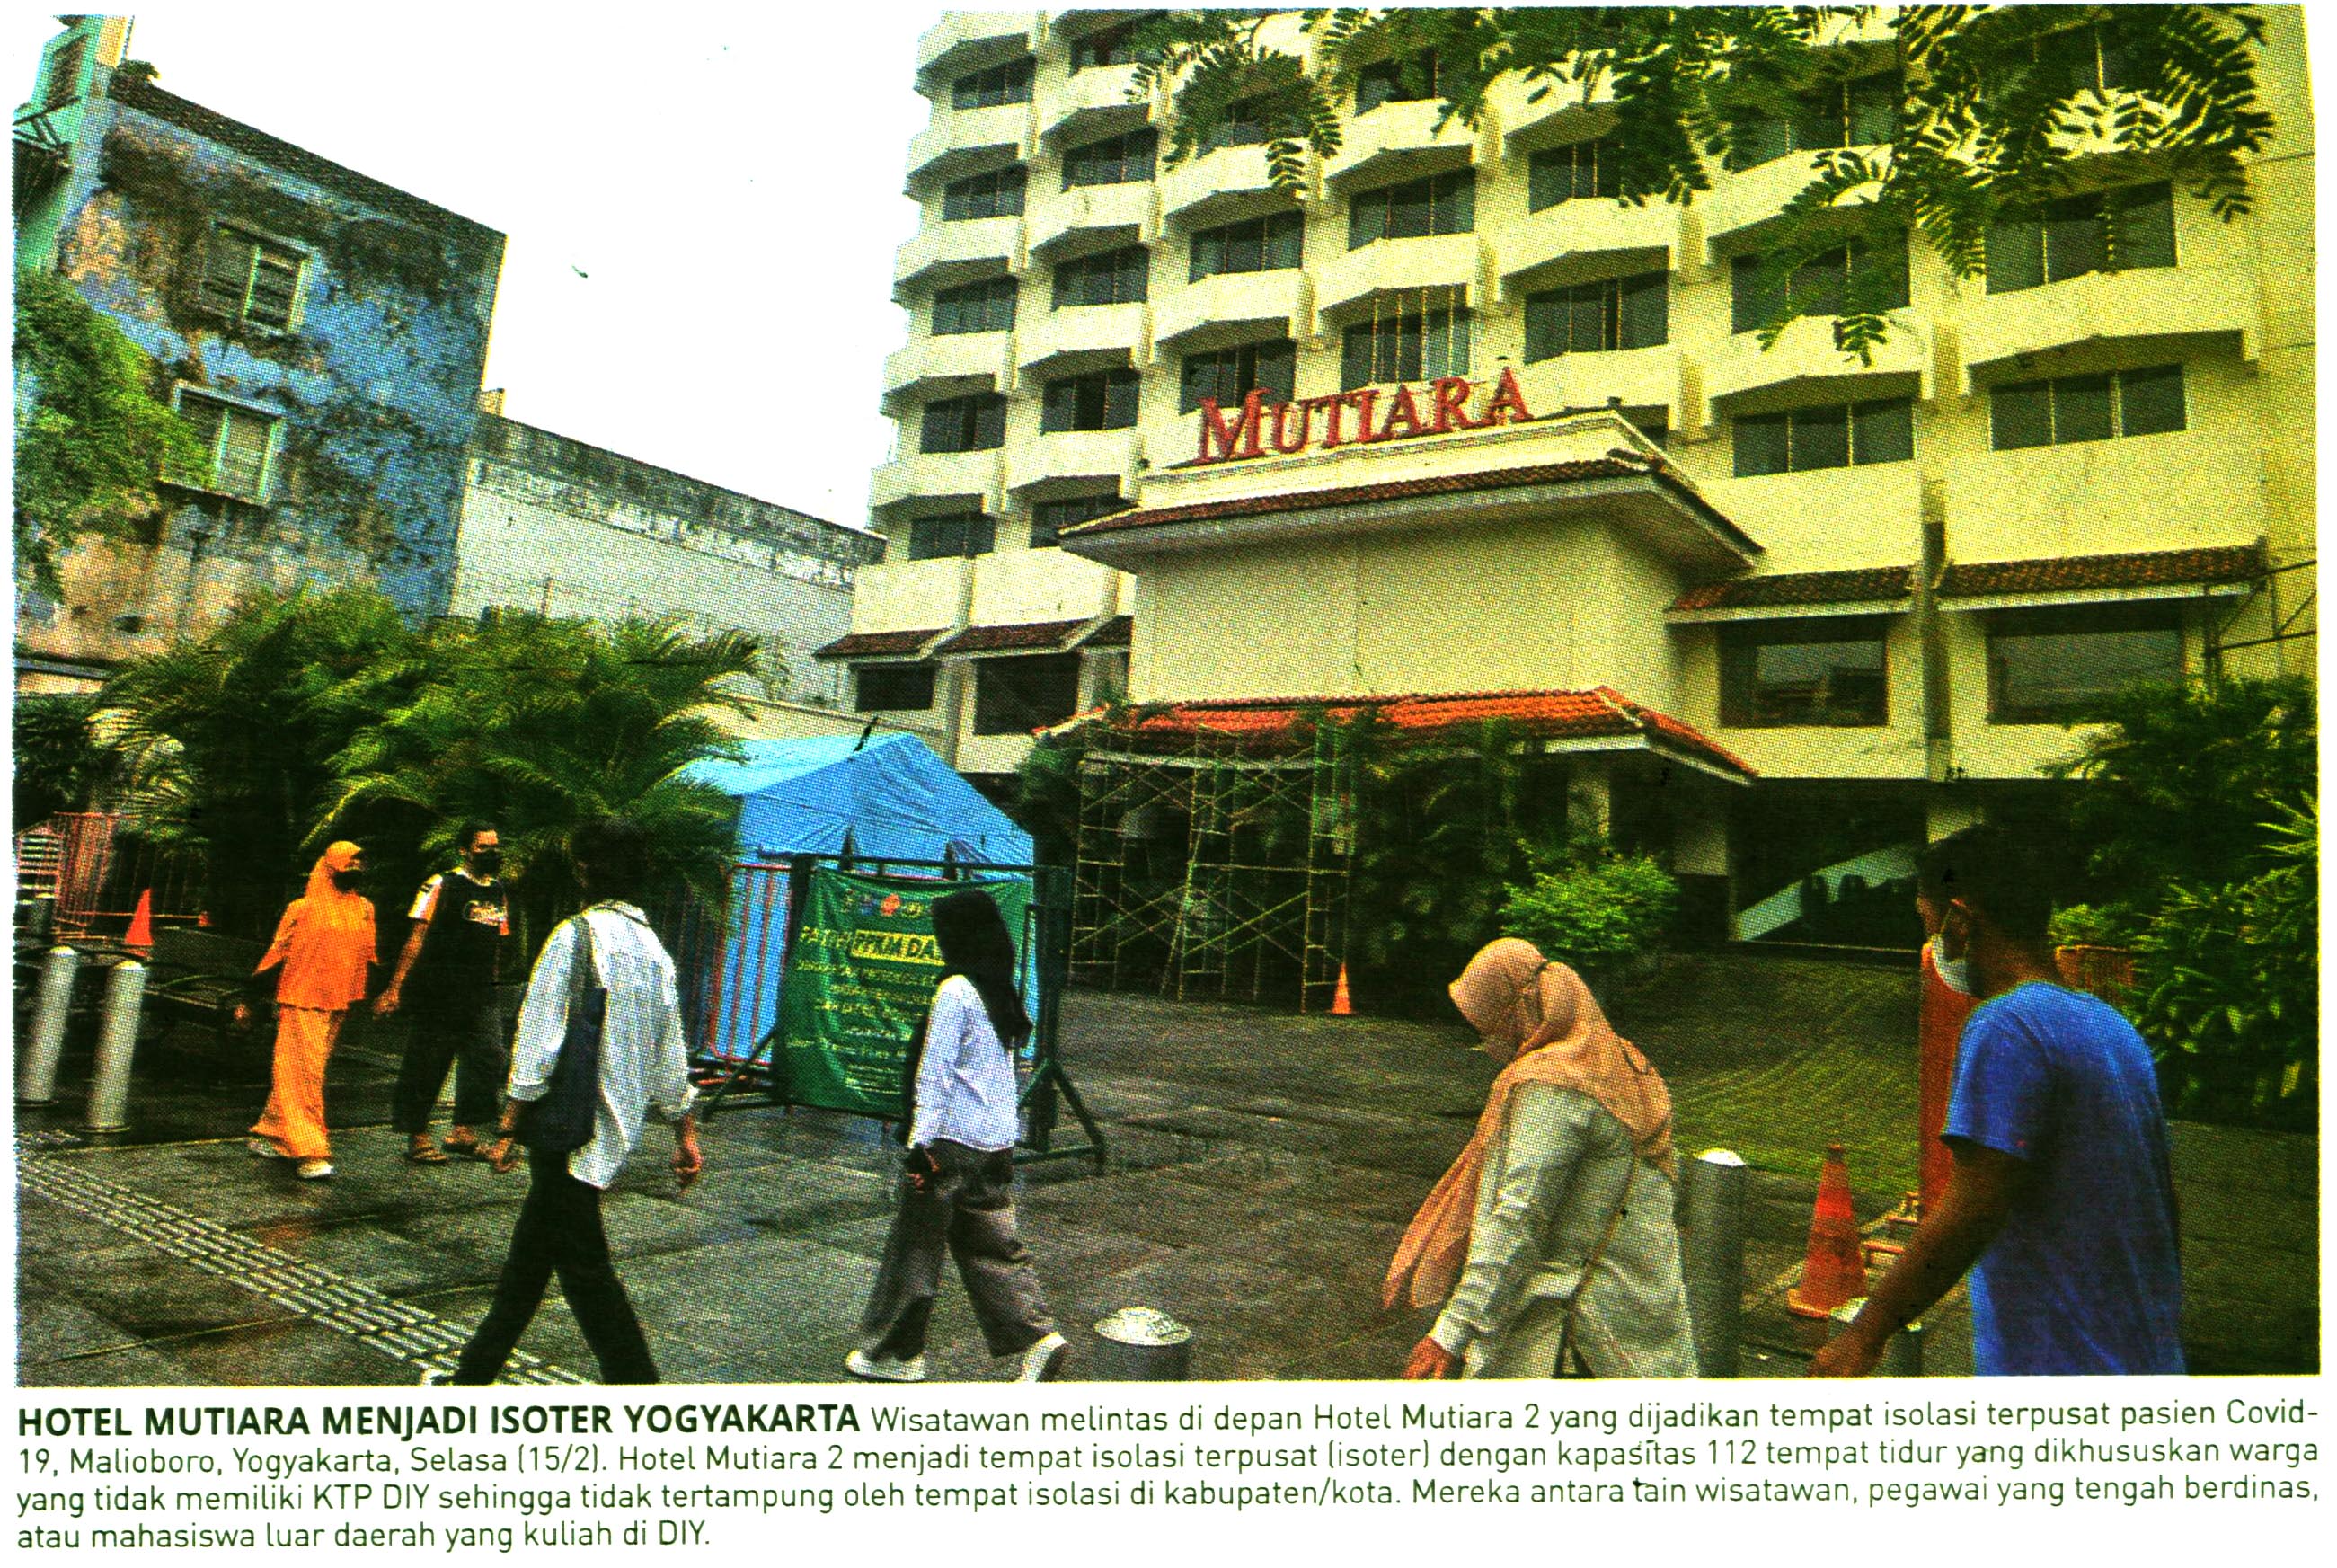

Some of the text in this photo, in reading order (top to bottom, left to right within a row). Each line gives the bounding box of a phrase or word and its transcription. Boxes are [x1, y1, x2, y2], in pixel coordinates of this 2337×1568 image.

[1192, 366, 1535, 464] MUTIARA
[854, 931, 901, 956] PPKM
[906, 936, 942, 960] DA
